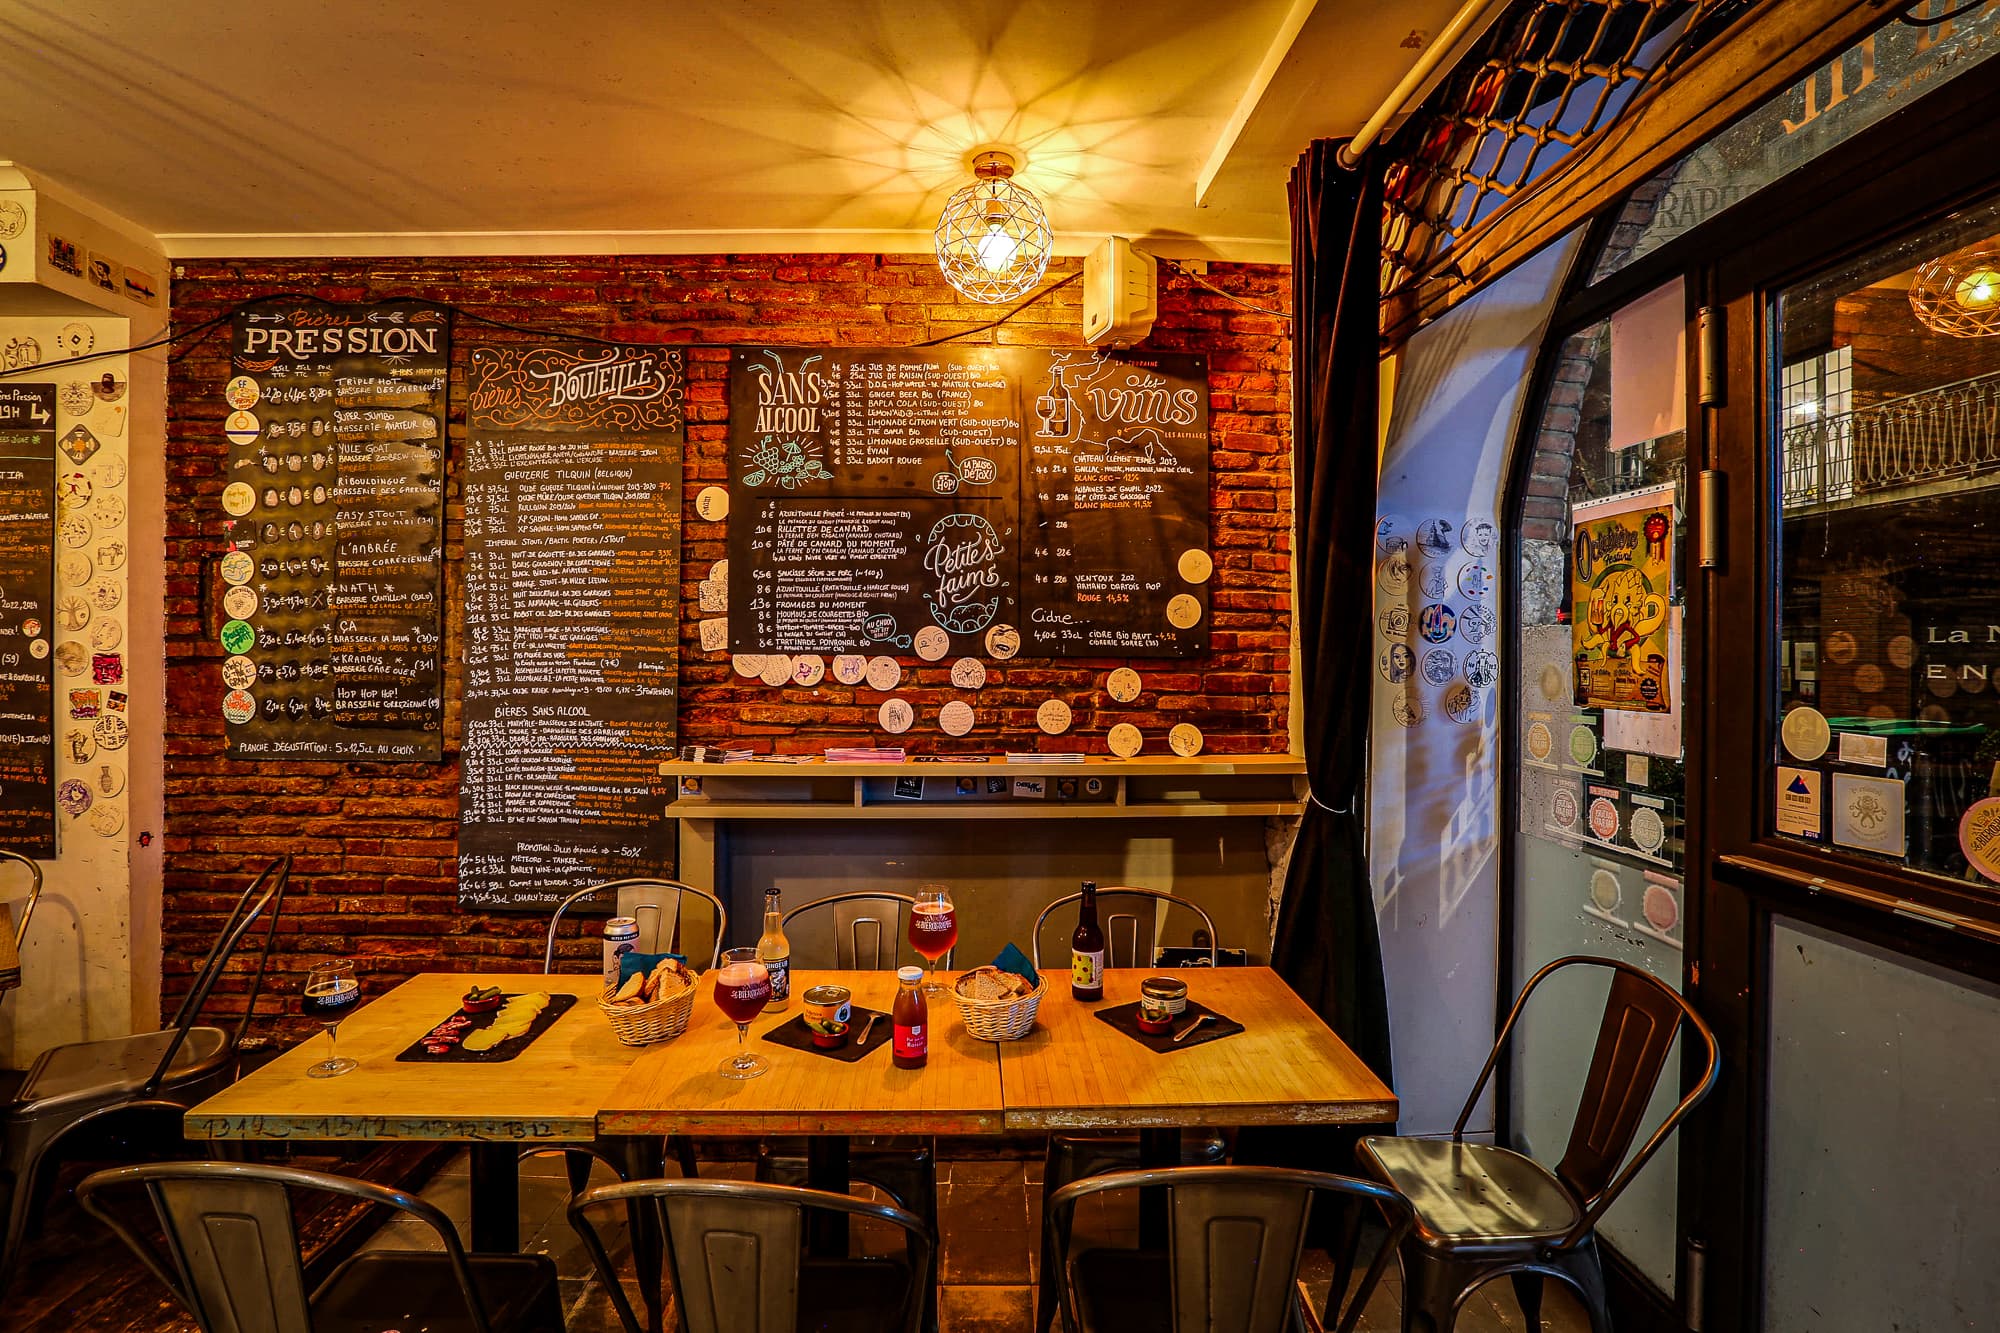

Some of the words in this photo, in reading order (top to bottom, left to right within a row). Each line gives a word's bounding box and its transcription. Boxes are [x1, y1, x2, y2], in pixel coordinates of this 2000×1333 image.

[244, 328, 438, 359] PRESSION
[530, 347, 666, 407] BOUTEILLE
[924, 372, 969, 380] (SUD-OUEST)
[335, 378, 375, 386] TRIPLE
[470, 362, 521, 411] bières
[337, 387, 373, 396] BRASSERIE
[377, 385, 394, 394] DES
[396, 383, 442, 393] GARRIGUES
[758, 372, 820, 406] SANS
[13, 389, 42, 402] Pression
[922, 390, 932, 398] BIO
[937, 390, 971, 399] (FRANCE)
[920, 400, 971, 408] (SUD-OUEST)
[334, 411, 362, 423] SUPER
[364, 411, 394, 421] JUMBO
[754, 406, 820, 433] ALCOOL
[333, 422, 380, 432] BRASSERIE
[867, 418, 906, 426] LIMONADE
[909, 418, 936, 426] CITRON
[960, 417, 1009, 430] (SUD-OUEST)
[939, 428, 992, 436] (SUD-OUEST)
[909, 436, 949, 445] GROSEILLE
[952, 438, 1004, 447] (SUD-OUEST)
[338, 444, 361, 454] YULE
[365, 444, 390, 452] GOAT
[508, 444, 528, 453] BARBE
[867, 447, 889, 455] ÉVIAN
[338, 454, 372, 463] BRASSERIE
[1073, 452, 1104, 463] CHÂTEAU
[1160, 457, 1178, 465] 2023
[964, 461, 971, 470] LA
[505, 470, 550, 481] GUEUZERIE
[555, 470, 591, 480] TILQUIN
[594, 468, 633, 480] (BELGIQUE)
[338, 476, 407, 486] RIBOULDINGUE
[936, 480, 955, 490] HOP!
[333, 487, 379, 496] BRASSERIE
[381, 486, 395, 494] DES
[398, 484, 441, 494] GARRIGUES
[1144, 485, 1164, 493] 2022
[335, 511, 364, 520] EASY
[367, 510, 406, 518] STOUT
[778, 510, 821, 518] AZUKITOUILLE
[335, 519, 372, 529] BRASSERIE
[518, 516, 527, 524] XP
[518, 526, 529, 534] XP
[846, 532, 872, 540] (ARNAUD
[341, 539, 398, 555] L'AMBRÉE
[777, 540, 794, 548] PÂTÉ
[848, 547, 874, 555] (ARNAUD
[924, 532, 1005, 578] Petites
[372, 554, 433, 566] CORRÉZIENNE
[339, 583, 378, 593] NATH
[776, 585, 820, 593] AZUKITOUILLE
[936, 563, 1000, 607] faims
[1077, 593, 1101, 602] ROUGE
[776, 601, 816, 609] FROMAGES
[340, 621, 357, 634] ÇA
[866, 622, 874, 630] AU
[875, 620, 892, 628] CHOIX
[334, 635, 377, 643] BRASSERIE
[1089, 631, 1112, 639] CIDRE
[1116, 631, 1130, 639] BIO
[1927, 626, 1970, 644] La
[341, 655, 383, 665] KRAMPUS
[338, 688, 357, 698] HOP
[360, 688, 379, 698] HOP
[381, 688, 398, 699] HOP!
[335, 700, 381, 709] BRASSERIE
[495, 702, 528, 718] BIÈRES
[533, 706, 555, 717] SANS
[557, 706, 591, 717] ALCOOL
[239, 743, 269, 752] PLANCHE
[378, 745, 389, 753] AU
[392, 745, 414, 754] CHOIX
[510, 866, 533, 874] BARLEY
